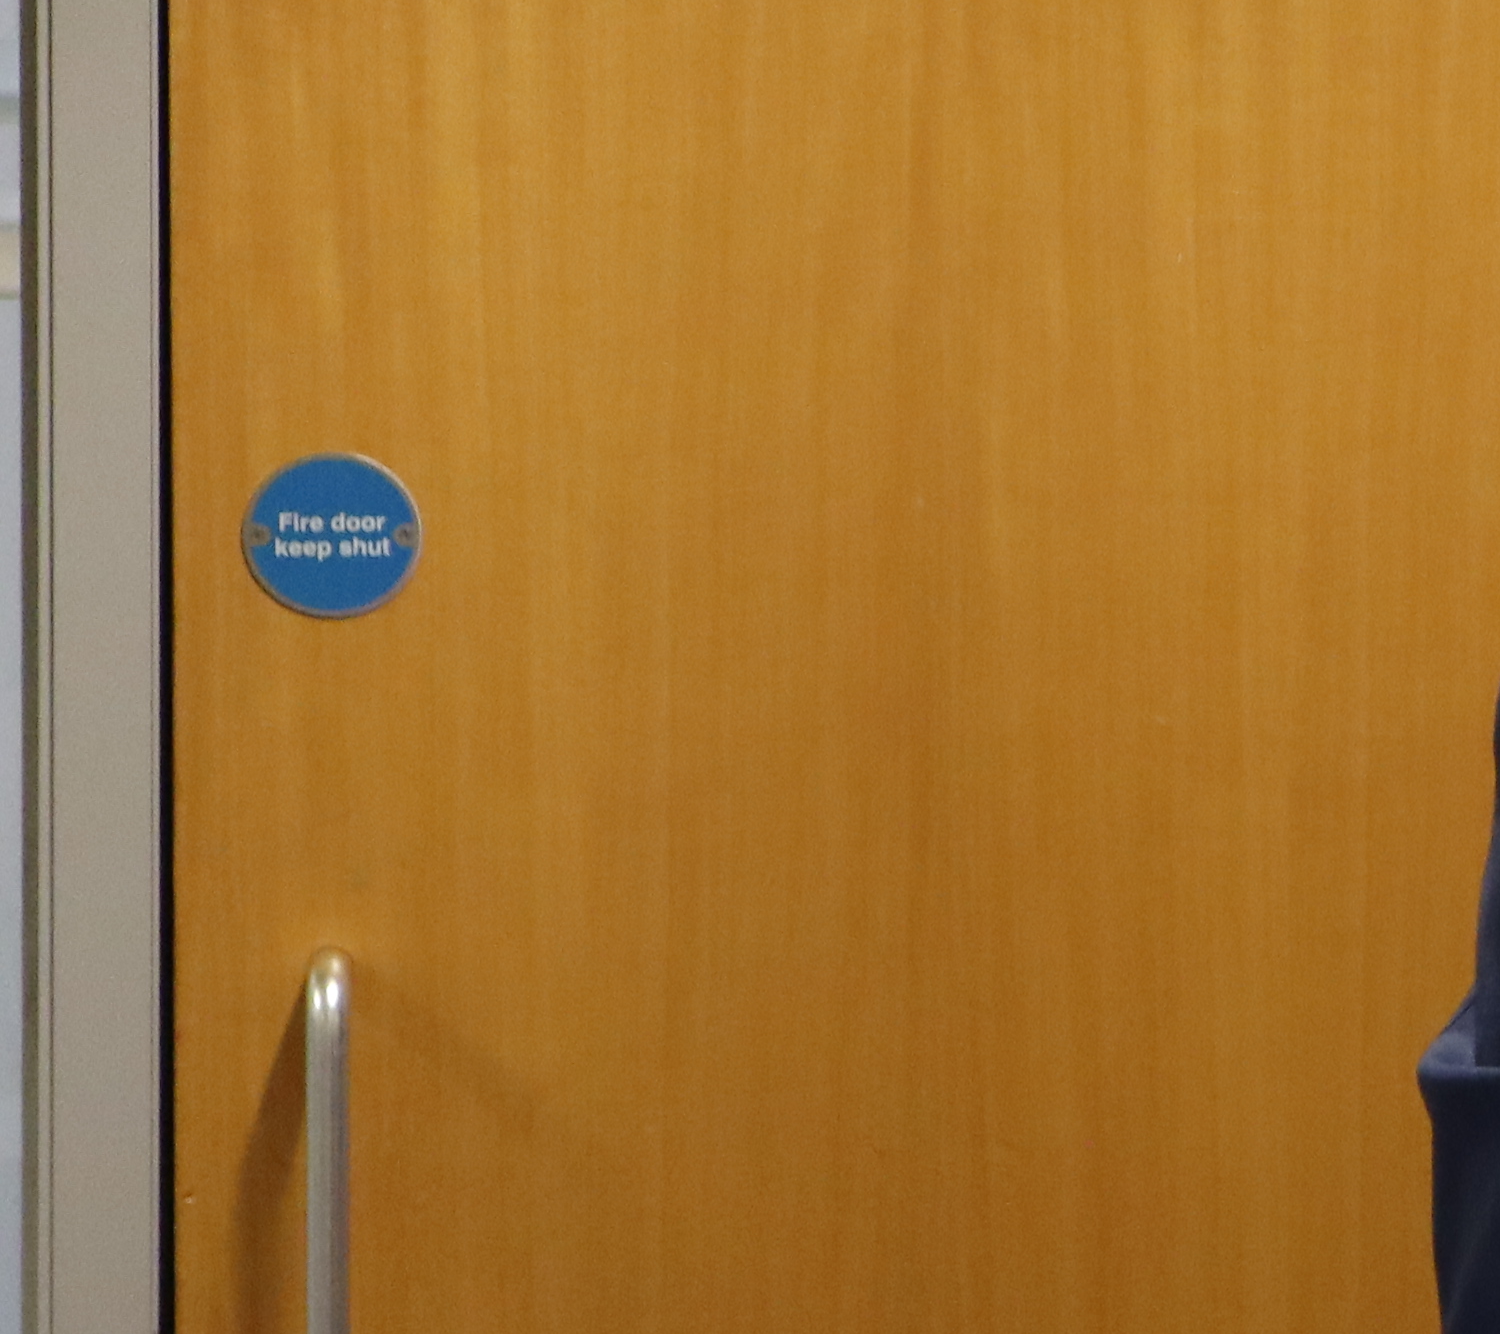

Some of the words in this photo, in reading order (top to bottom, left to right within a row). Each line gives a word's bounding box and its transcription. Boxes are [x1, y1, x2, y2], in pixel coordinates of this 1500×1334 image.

[278, 512, 324, 533] Fire
[330, 512, 386, 533] door
[274, 536, 332, 563] keep
[338, 535, 391, 557] shut
